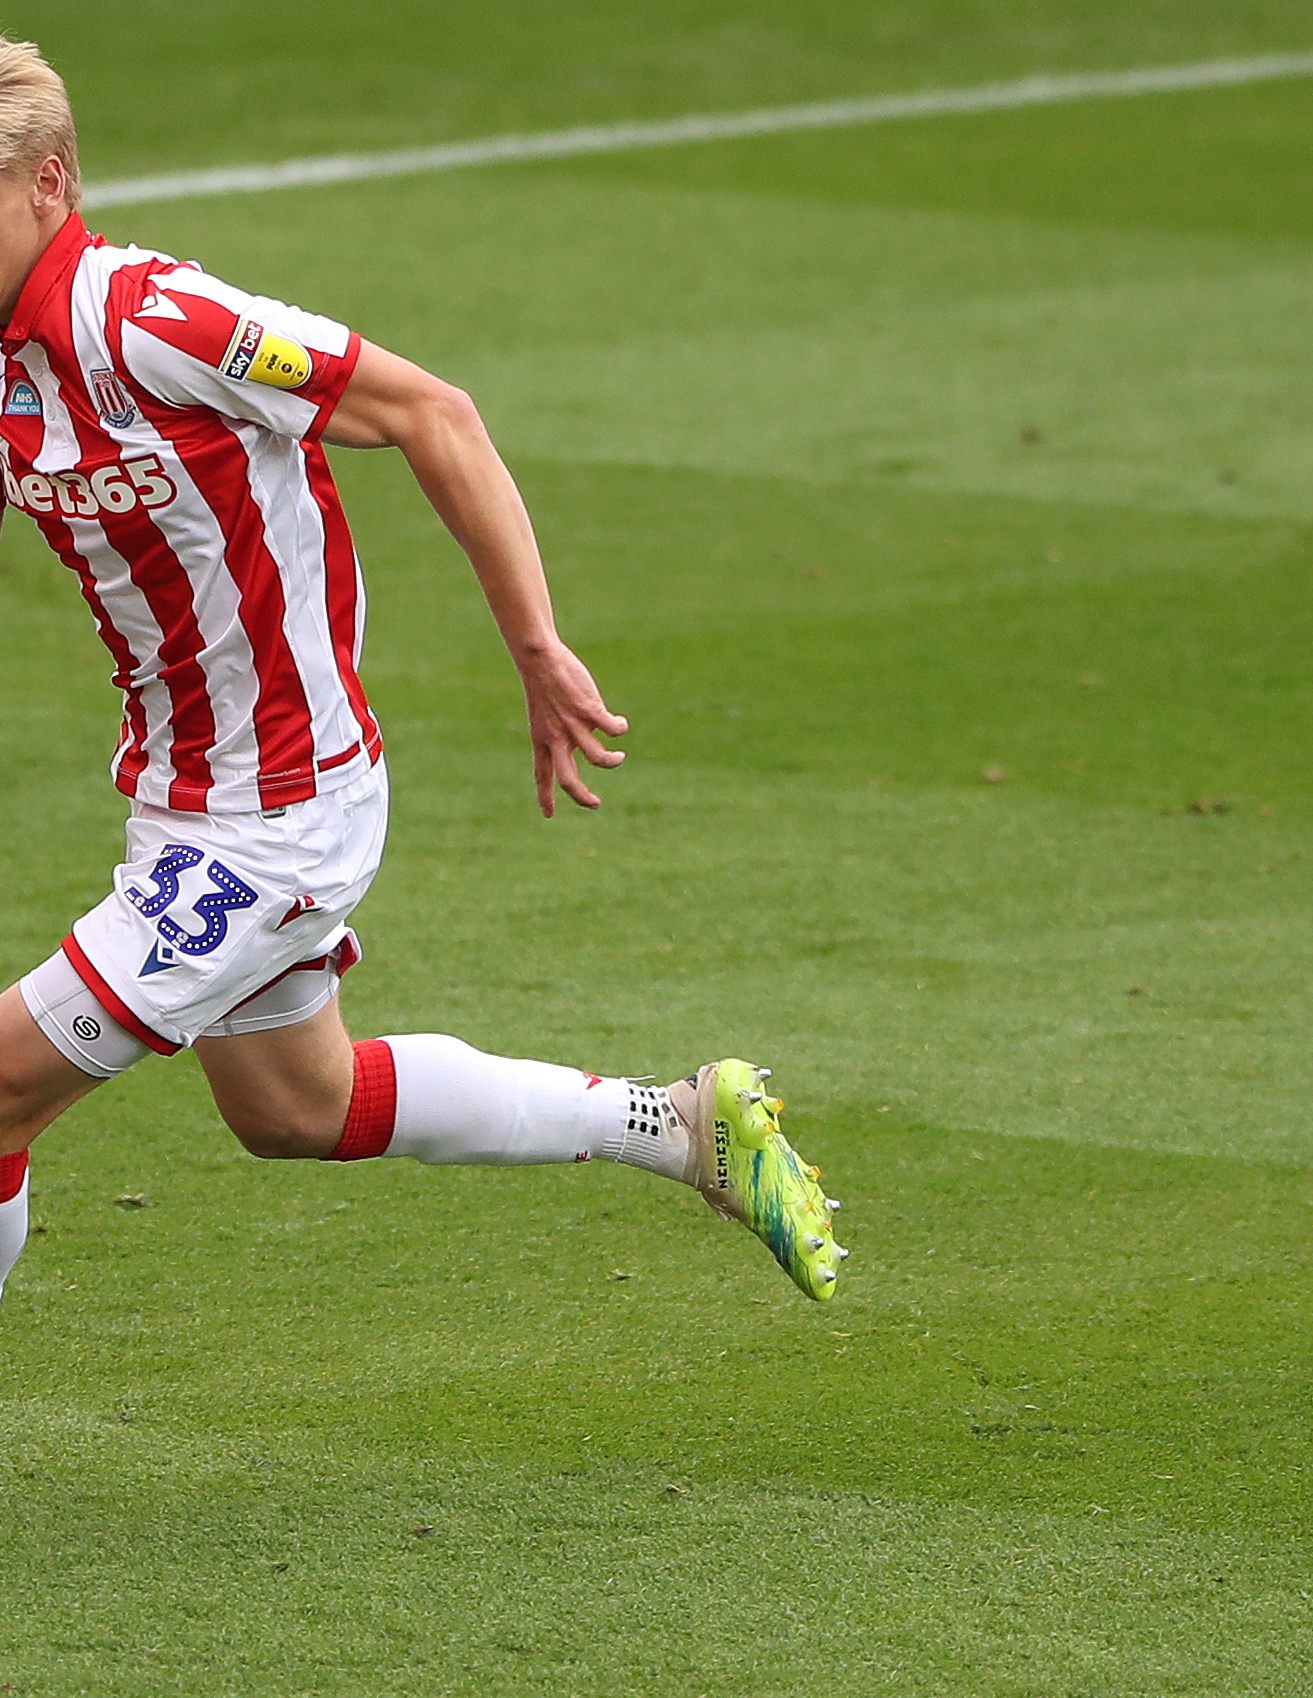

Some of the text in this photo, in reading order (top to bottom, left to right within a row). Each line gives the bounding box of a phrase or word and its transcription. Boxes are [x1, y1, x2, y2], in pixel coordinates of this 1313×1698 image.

[230, 322, 262, 377] sky bet
[15, 392, 33, 403] NHS
[124, 843, 259, 957] 33
[714, 1119, 729, 1190] NEMESIS
